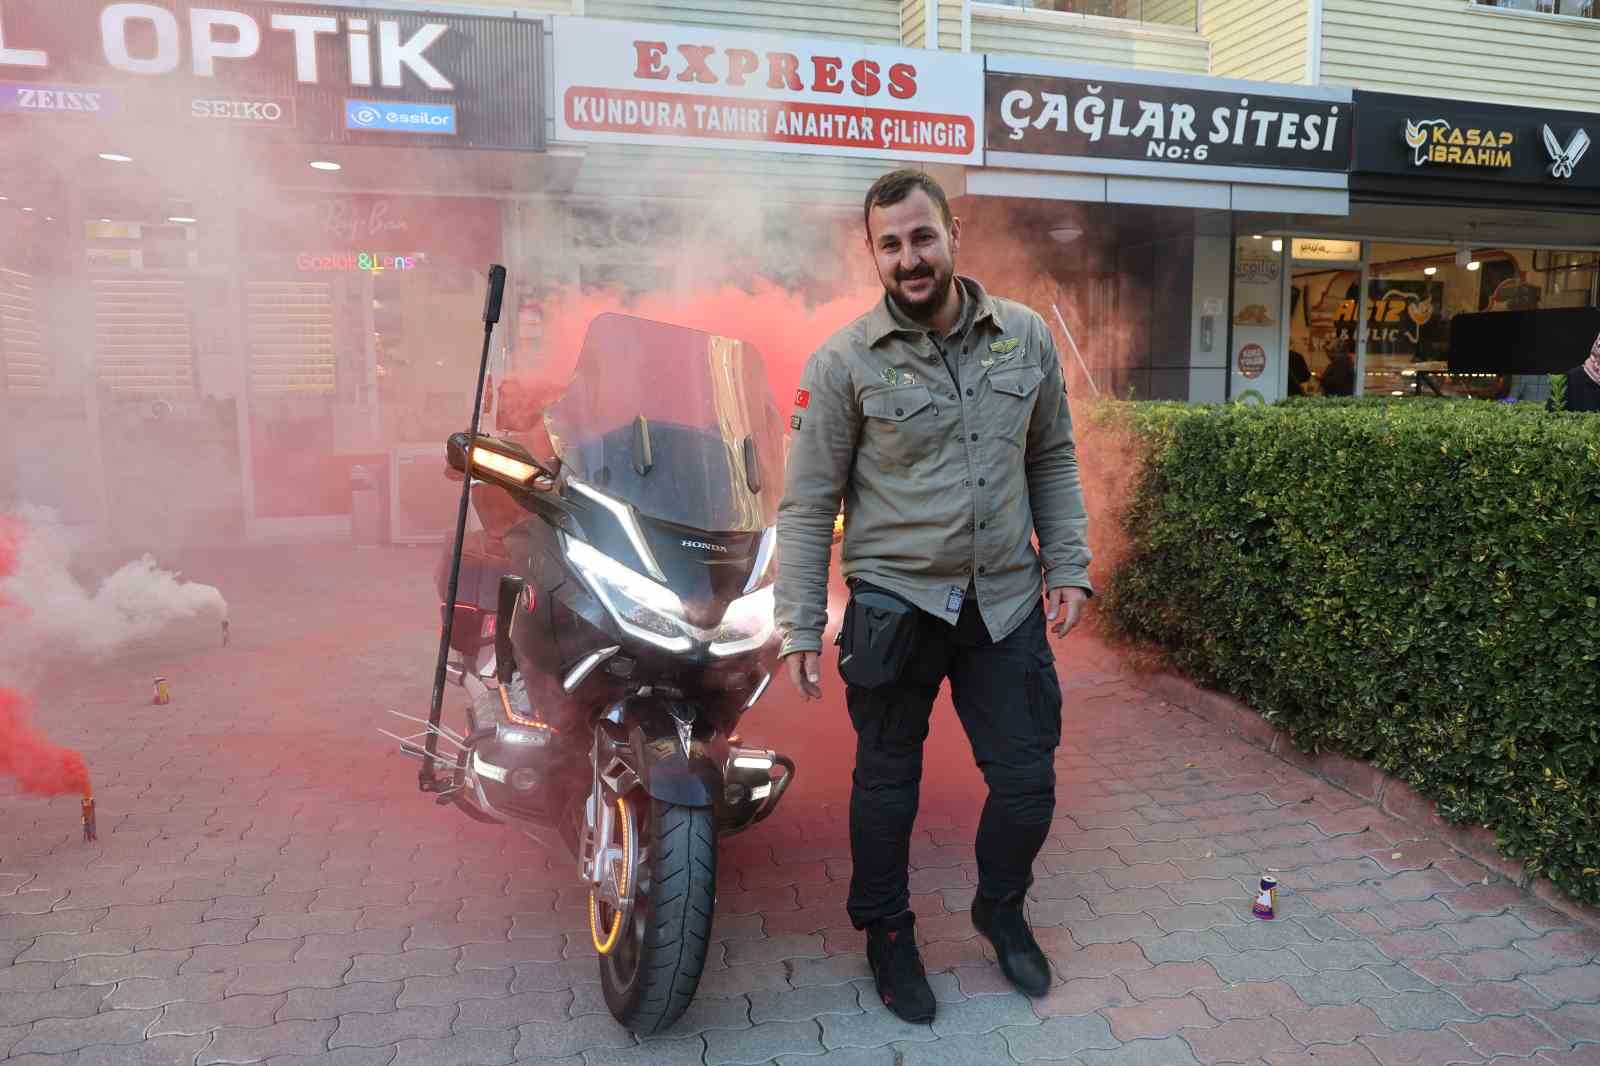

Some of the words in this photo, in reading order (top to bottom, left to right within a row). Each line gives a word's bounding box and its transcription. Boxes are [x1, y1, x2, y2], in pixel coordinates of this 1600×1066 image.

[633, 40, 917, 99] EXPRESS
[17, 89, 102, 111] ZEISS
[191, 99, 281, 120] SEIKO
[385, 111, 449, 125] essilor
[572, 96, 687, 129] KUNDURA
[775, 111, 874, 140] ANAHTAR
[1000, 85, 1197, 142] ÇAĞLAR
[1433, 127, 1513, 148] KASAP
[1146, 140, 1209, 160] No:6
[681, 540, 728, 553] HONDA
